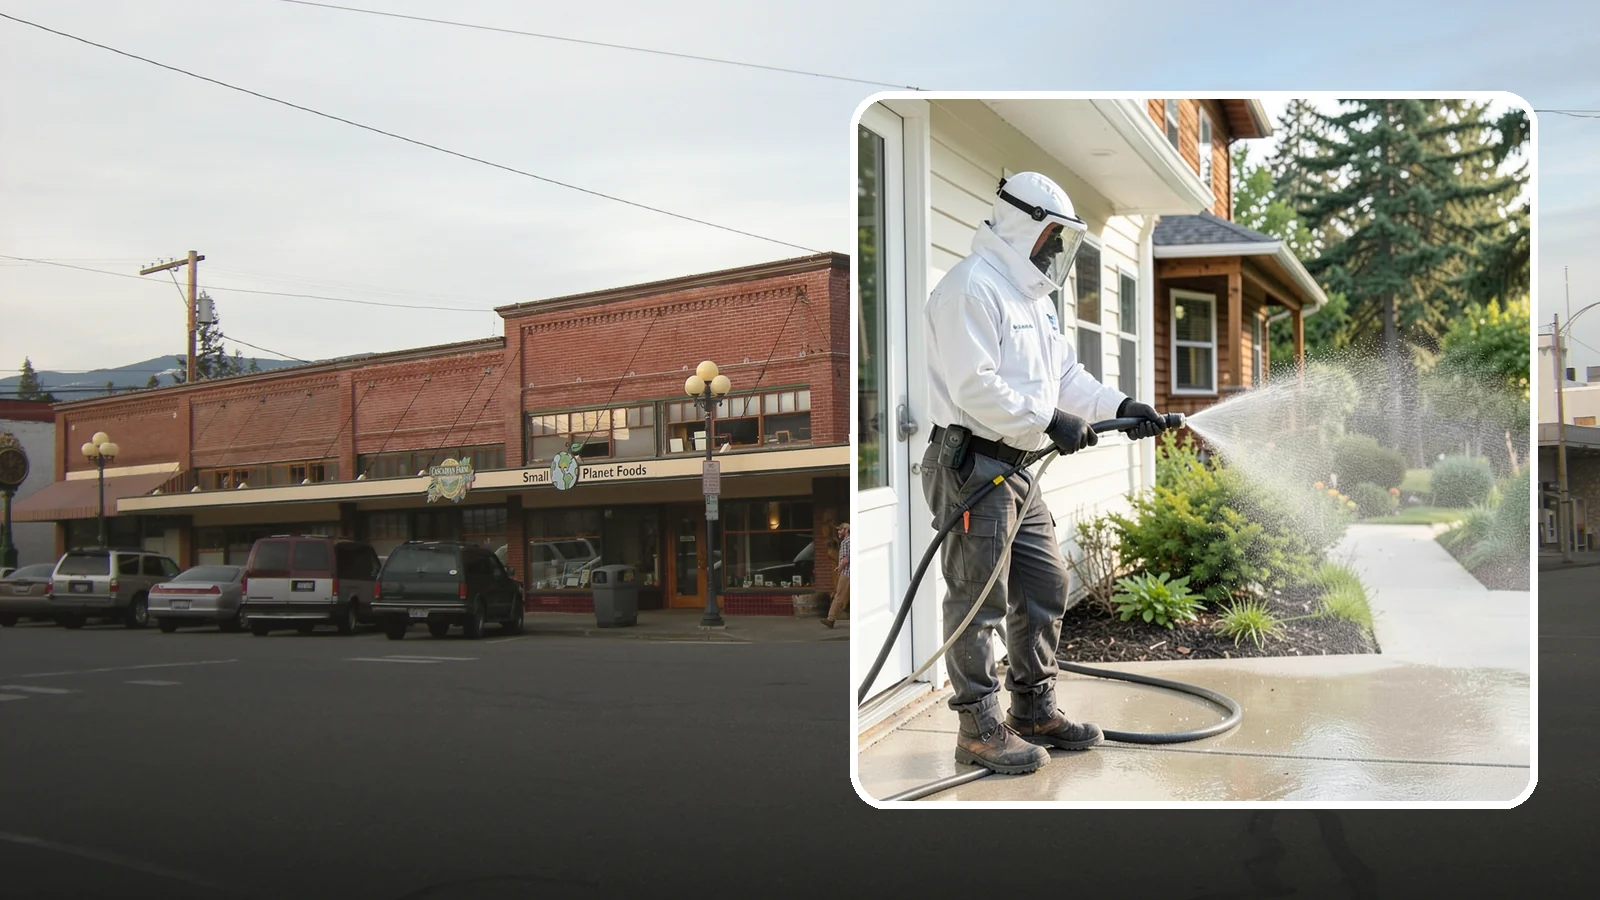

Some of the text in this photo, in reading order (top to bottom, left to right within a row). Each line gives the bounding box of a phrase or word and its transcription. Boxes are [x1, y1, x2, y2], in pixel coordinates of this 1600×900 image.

[523, 464, 647, 483] Small Planet Foods
